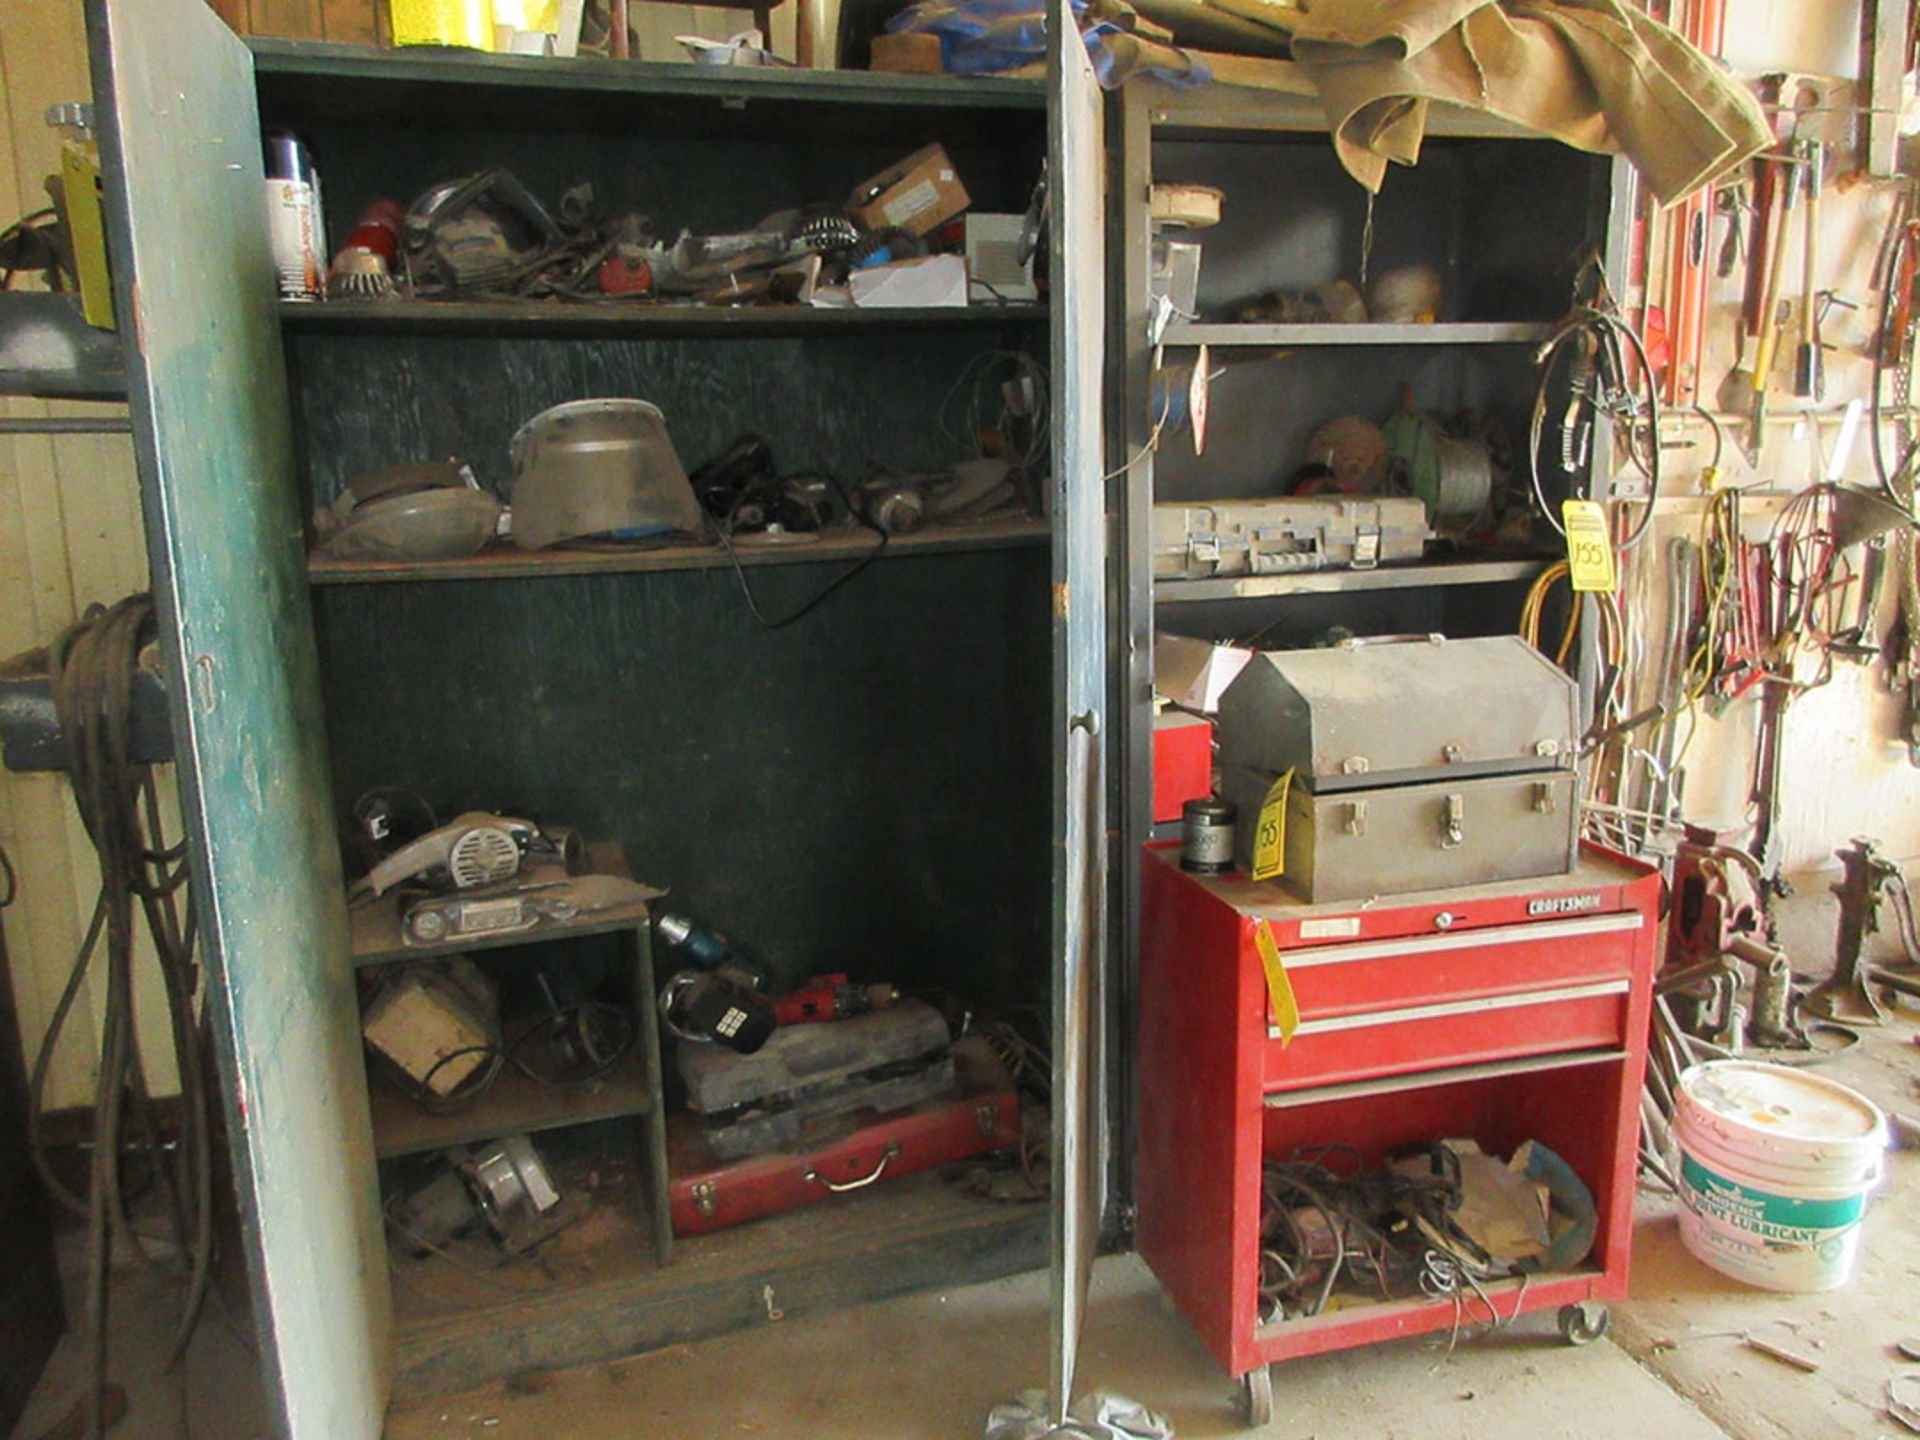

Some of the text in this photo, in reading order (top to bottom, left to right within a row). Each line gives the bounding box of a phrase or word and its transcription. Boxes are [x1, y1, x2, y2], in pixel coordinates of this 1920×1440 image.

[1575, 542, 1604, 565] 155
[1527, 894, 1601, 915] CRAFTSMAN
[1730, 1214, 1819, 1242] LUBRICANT
